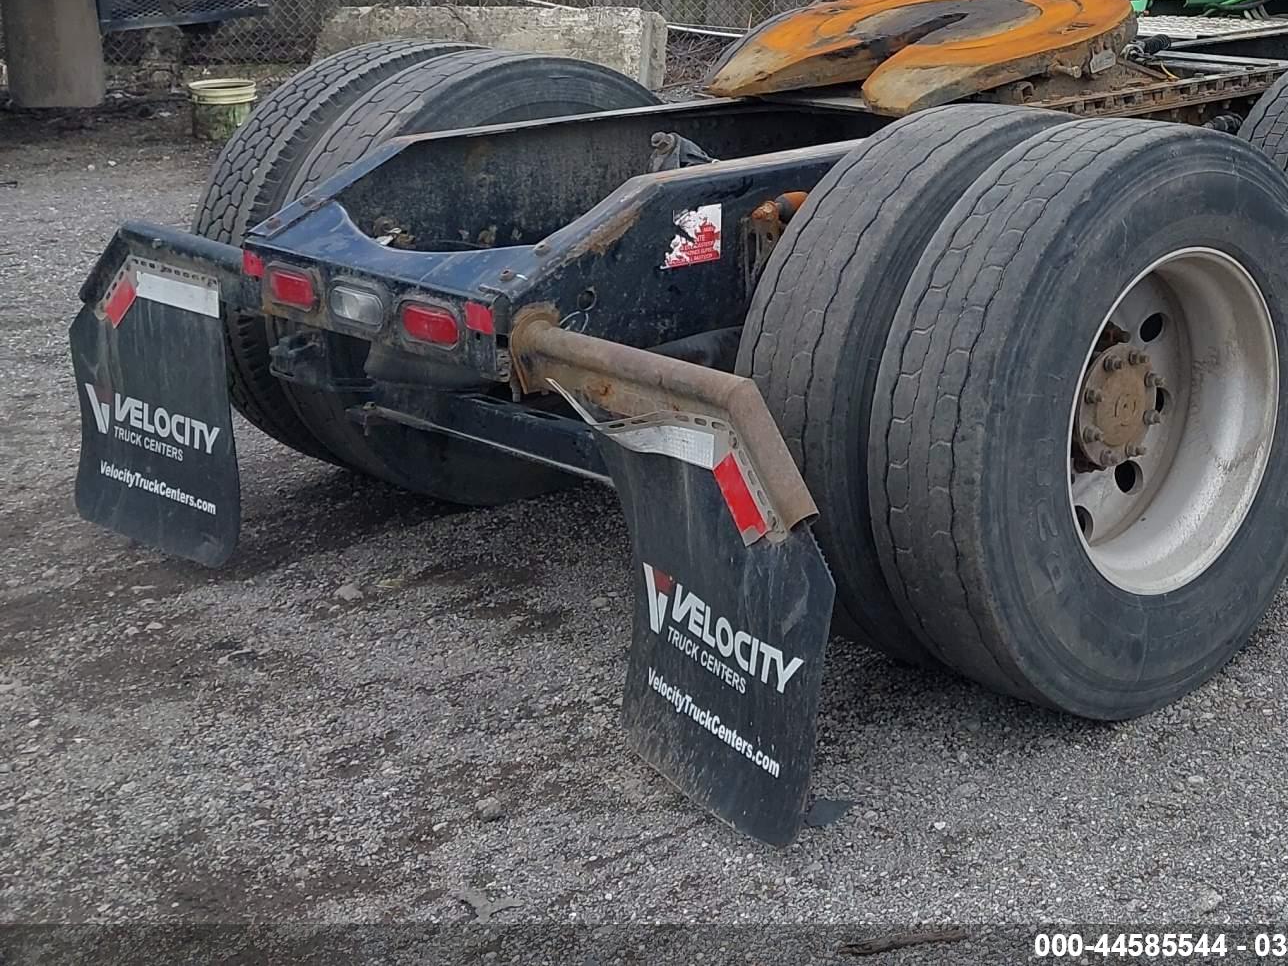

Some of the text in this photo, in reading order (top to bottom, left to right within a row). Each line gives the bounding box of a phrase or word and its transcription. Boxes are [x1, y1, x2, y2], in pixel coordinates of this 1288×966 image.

[113, 425, 184, 462] TRUCK CENTERS
[114, 392, 220, 455] VELOCITY
[100, 459, 217, 515] VelocityTruckCenters.com
[667, 625, 747, 695] TRUCK CENTERS
[671, 583, 804, 694] VELOCITY
[648, 666, 780, 778] VelocityTruckCenters.com
